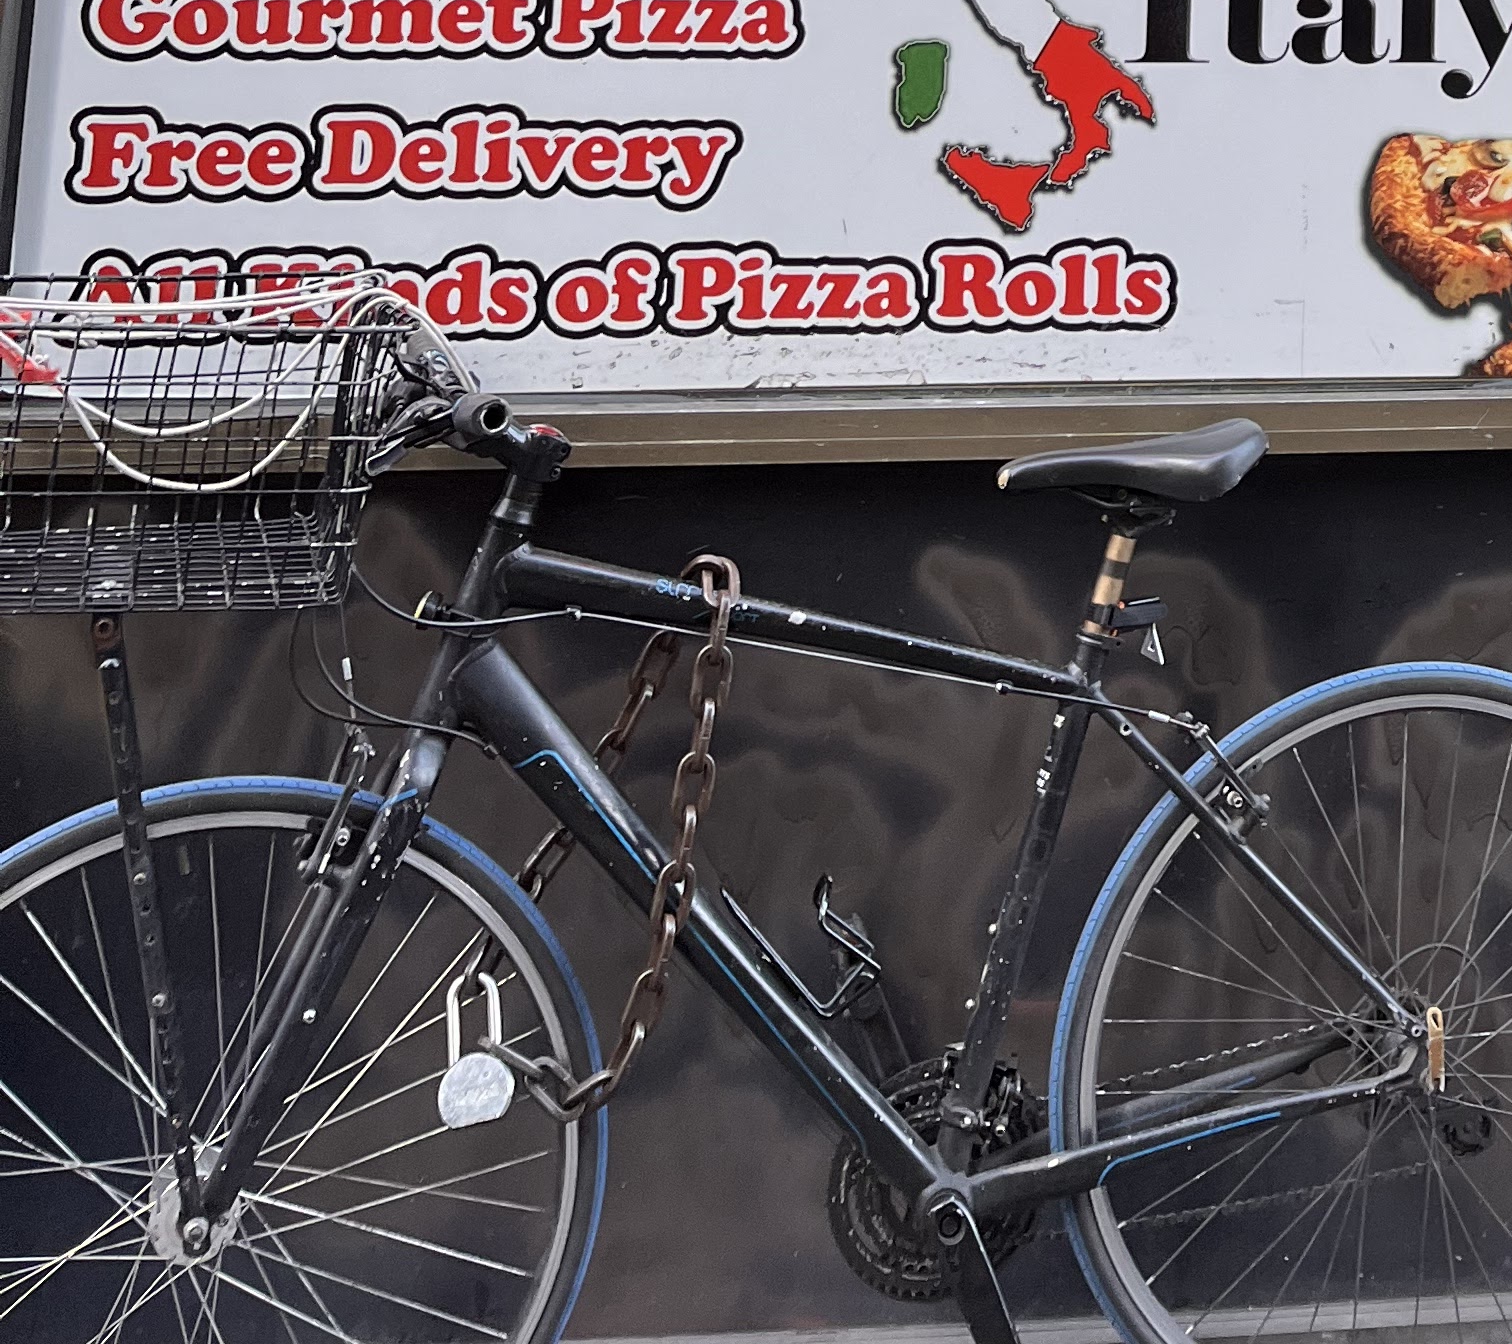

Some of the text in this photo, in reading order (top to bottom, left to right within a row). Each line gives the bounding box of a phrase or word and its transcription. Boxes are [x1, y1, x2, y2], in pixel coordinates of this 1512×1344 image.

[75, 114, 734, 203] Free Delivery
[550, 248, 665, 329] of
[669, 247, 915, 330] Pizza
[925, 244, 1173, 326] Rolls
